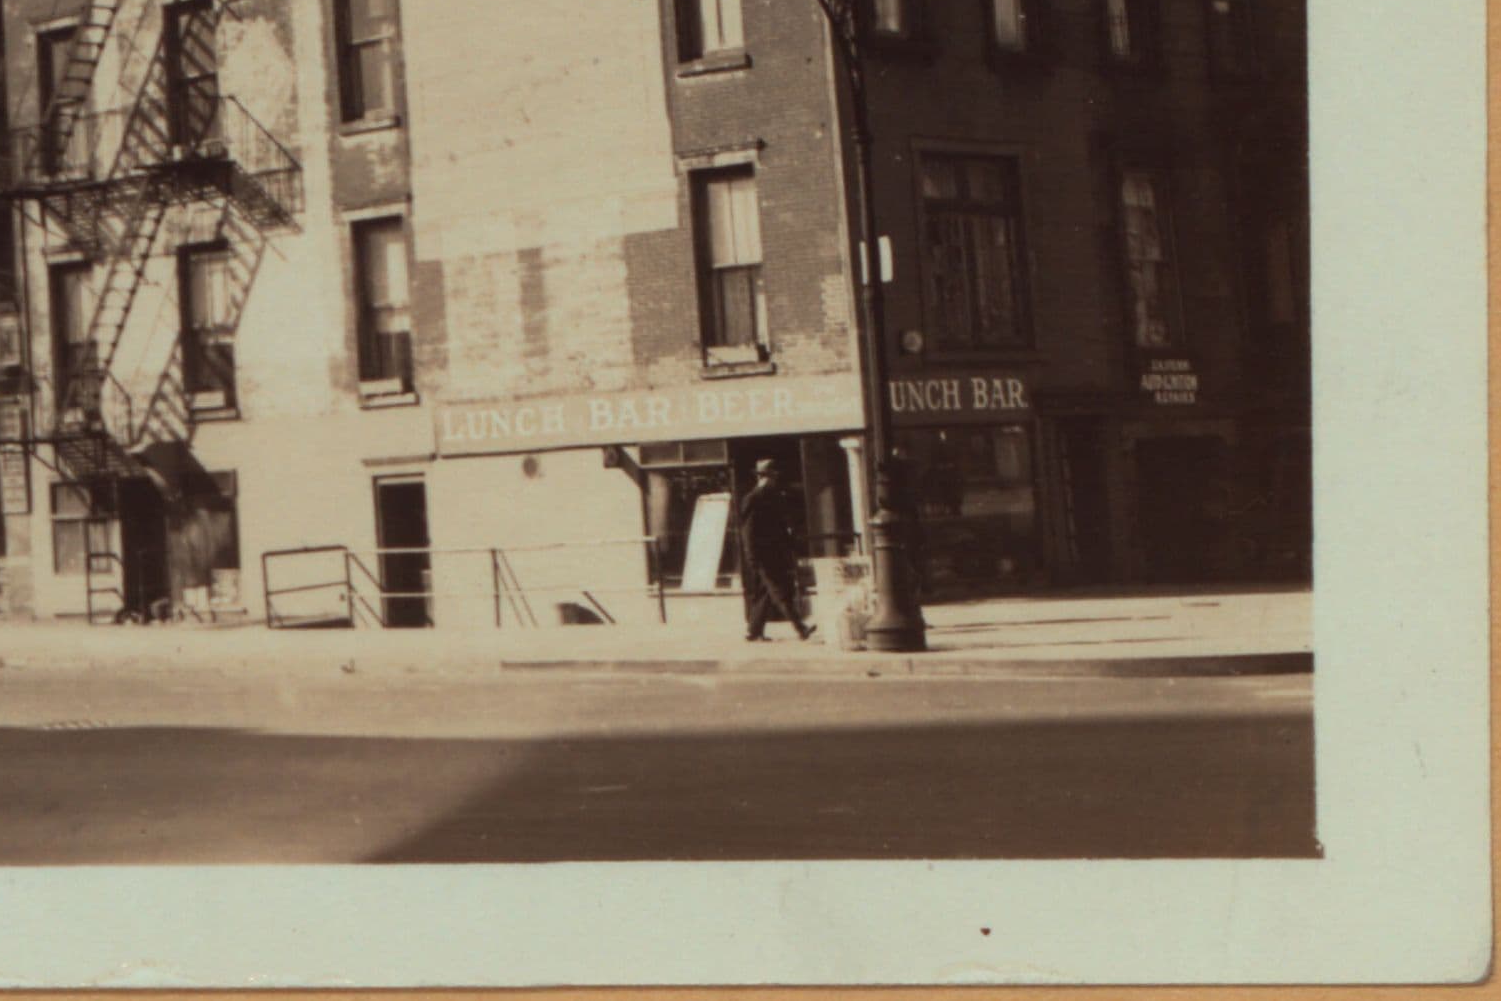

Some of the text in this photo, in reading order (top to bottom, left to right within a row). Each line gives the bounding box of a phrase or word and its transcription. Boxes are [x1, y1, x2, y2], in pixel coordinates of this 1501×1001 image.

[441, 404, 565, 441] LUNCH
[587, 395, 671, 433] BAR
[699, 387, 795, 426] BEER
[889, 379, 961, 411] UNCH
[971, 376, 1028, 409] BAR
